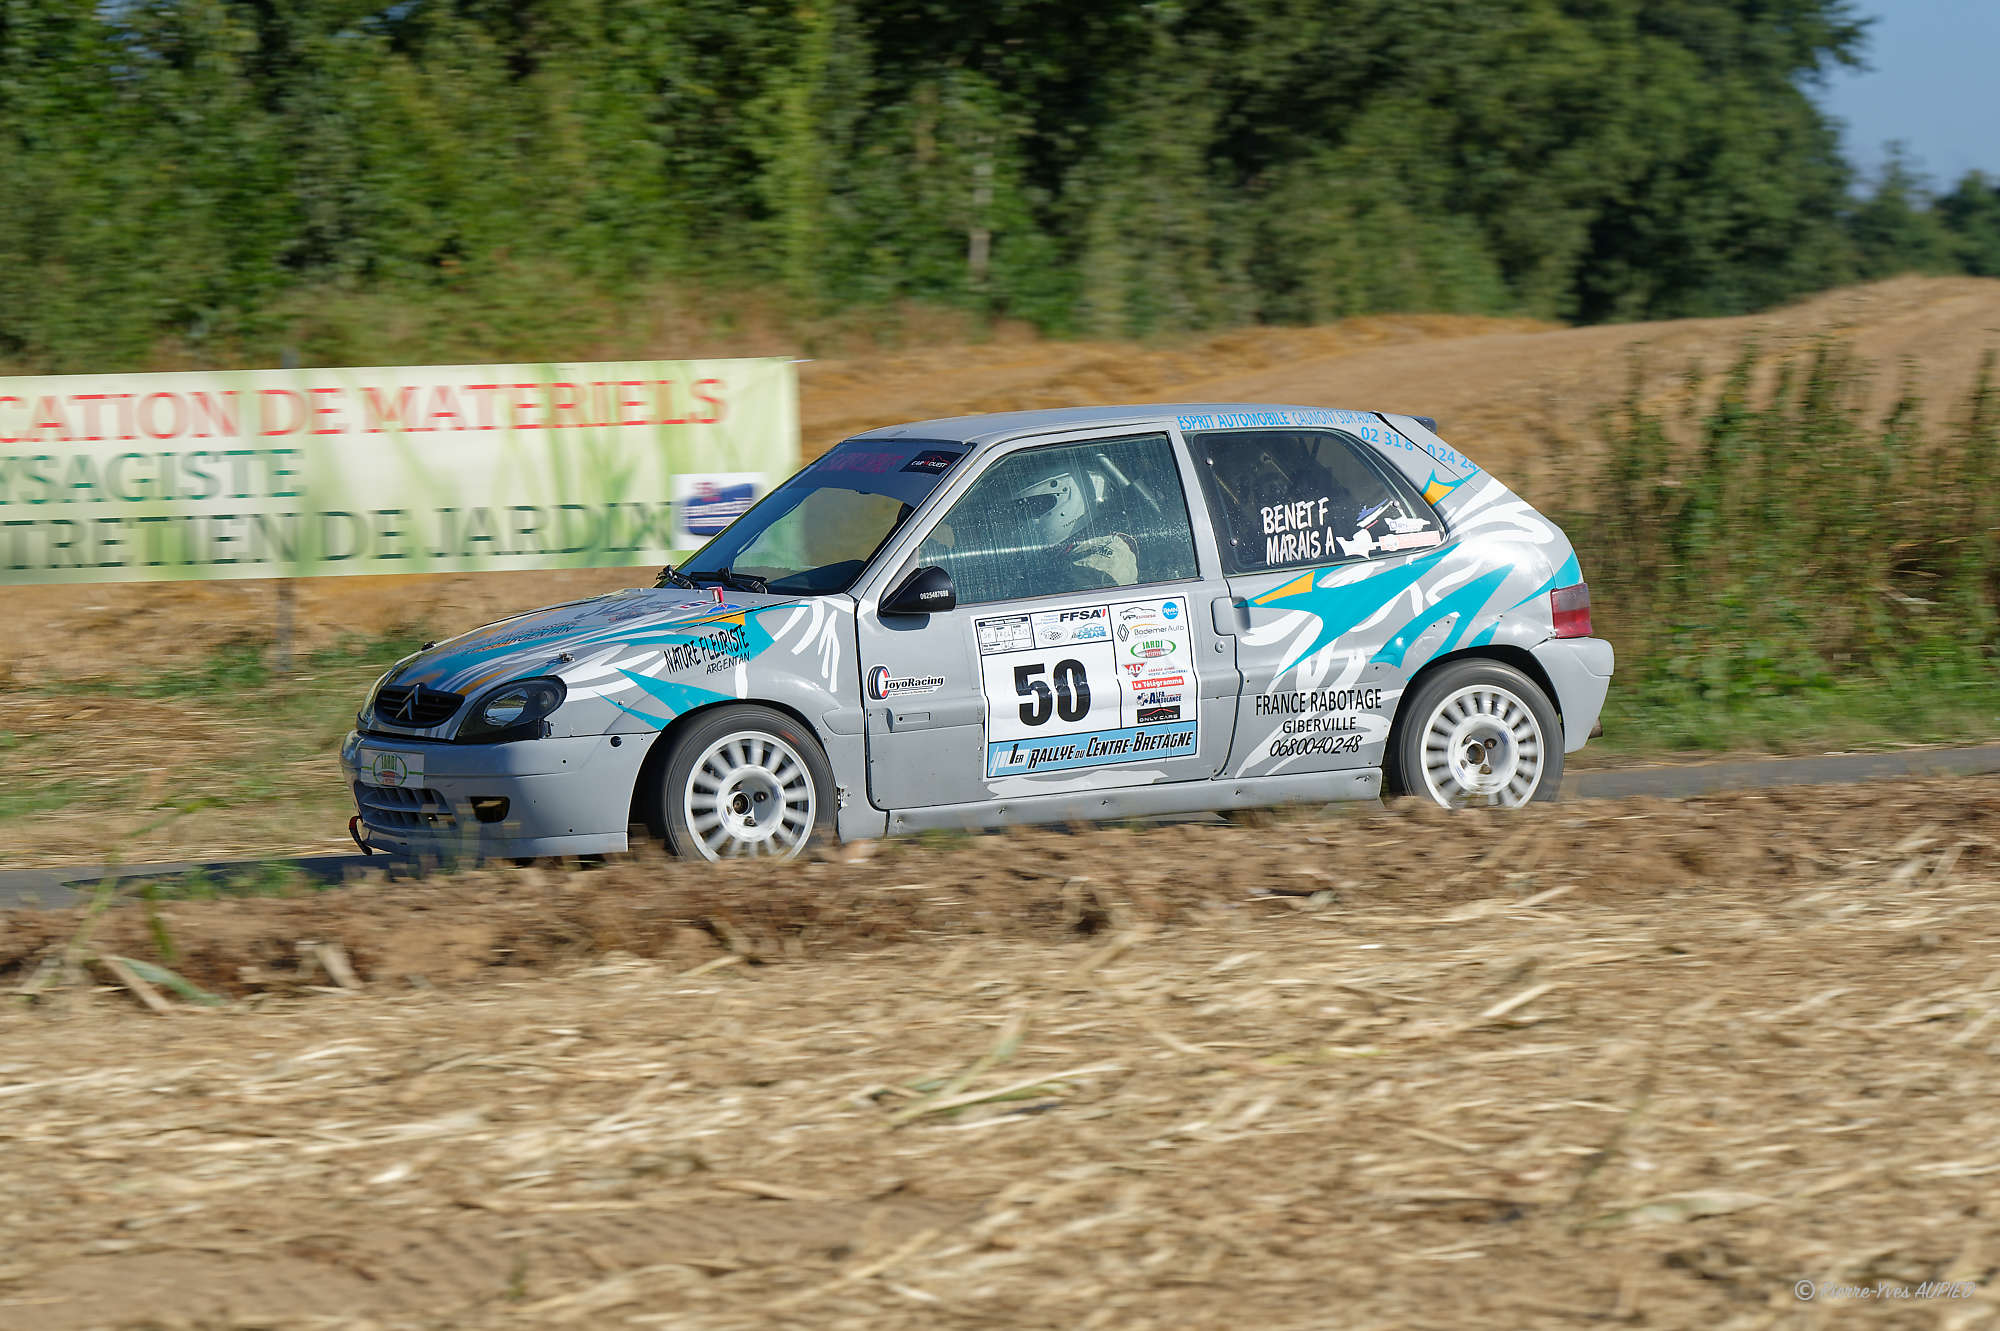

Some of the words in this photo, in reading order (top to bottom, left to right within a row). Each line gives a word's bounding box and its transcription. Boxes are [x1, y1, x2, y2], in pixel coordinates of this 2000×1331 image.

[255, 387, 348, 437] DE
[361, 378, 727, 434] MATERIELS
[1177, 415, 1213, 430] ESPRIT
[1217, 411, 1290, 429] AUTOMOBILE
[1361, 426, 1378, 442] 02
[1261, 500, 1315, 534] BENET
[1318, 497, 1329, 525] F
[316, 508, 413, 561] DE
[1266, 530, 1321, 565] MARAIS
[1325, 526, 1335, 556] A
[1060, 609, 1101, 622] FFSA
[664, 640, 701, 674] NATURE
[699, 624, 749, 661] FLEURISTE
[706, 651, 750, 675] ARGENTAN
[1128, 664, 1142, 673] AD
[884, 676, 944, 690] ToyoRacing
[1014, 659, 1091, 726] 50
[1255, 692, 1306, 716] FRANCE
[1310, 688, 1382, 712] RABOTAGE
[1282, 717, 1356, 733] GIBERVILLE
[1027, 744, 1075, 769] RALLYE
[1085, 731, 1193, 758] CENTRE-BRETAGNE
[1269, 735, 1363, 757] 0680040248
